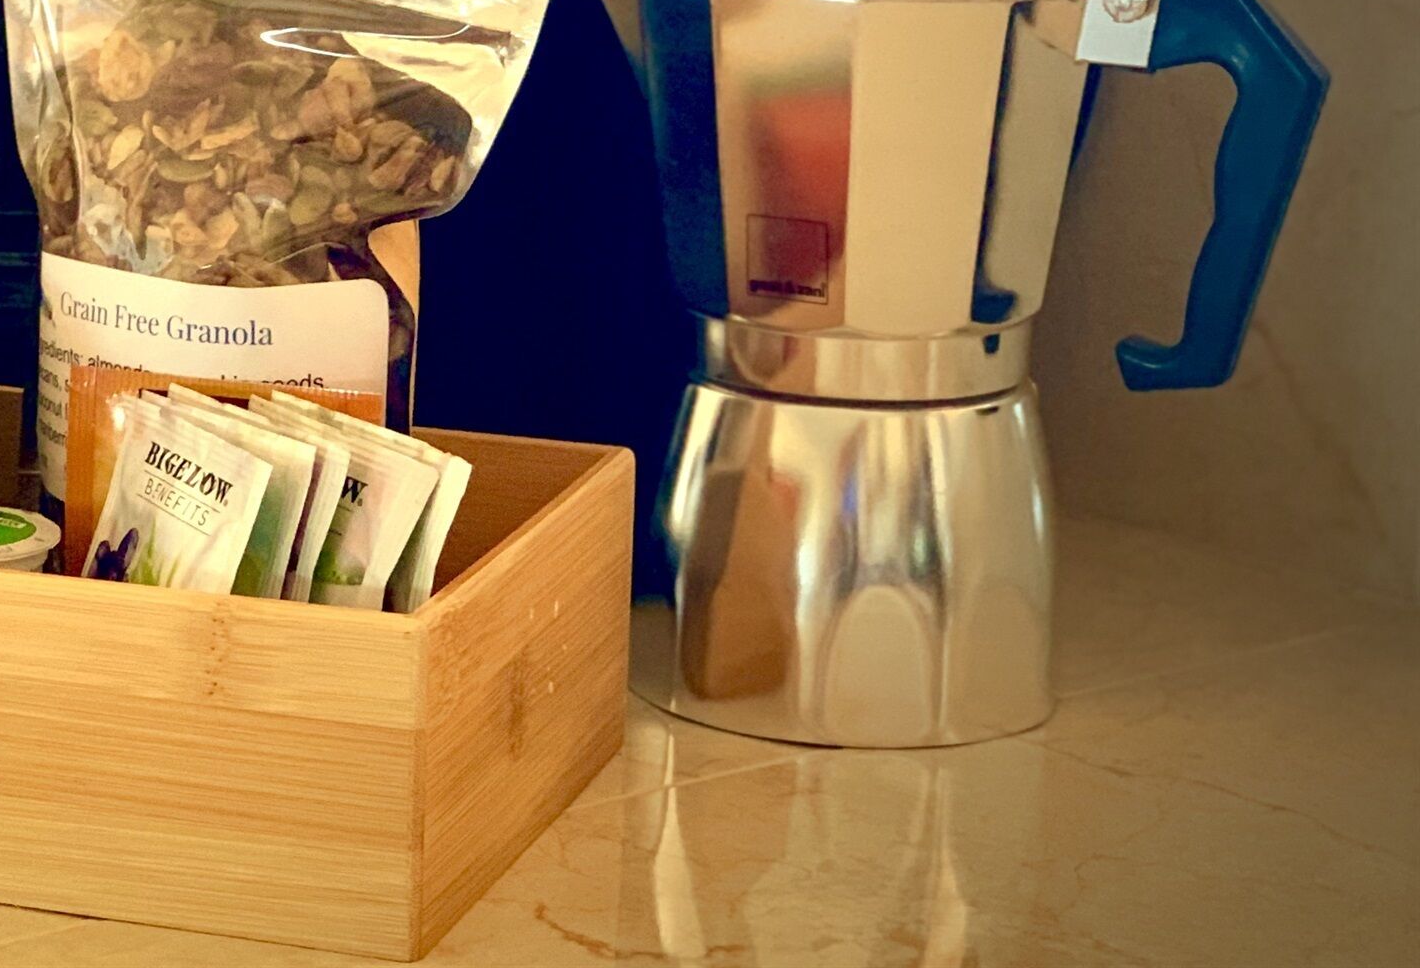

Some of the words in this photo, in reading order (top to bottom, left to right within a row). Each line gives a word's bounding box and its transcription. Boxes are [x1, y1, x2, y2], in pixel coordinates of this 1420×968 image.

[60, 291, 108, 326] Grain
[115, 304, 159, 336] Free
[167, 315, 274, 346] Granola
[143, 478, 211, 527] BENEFITS
